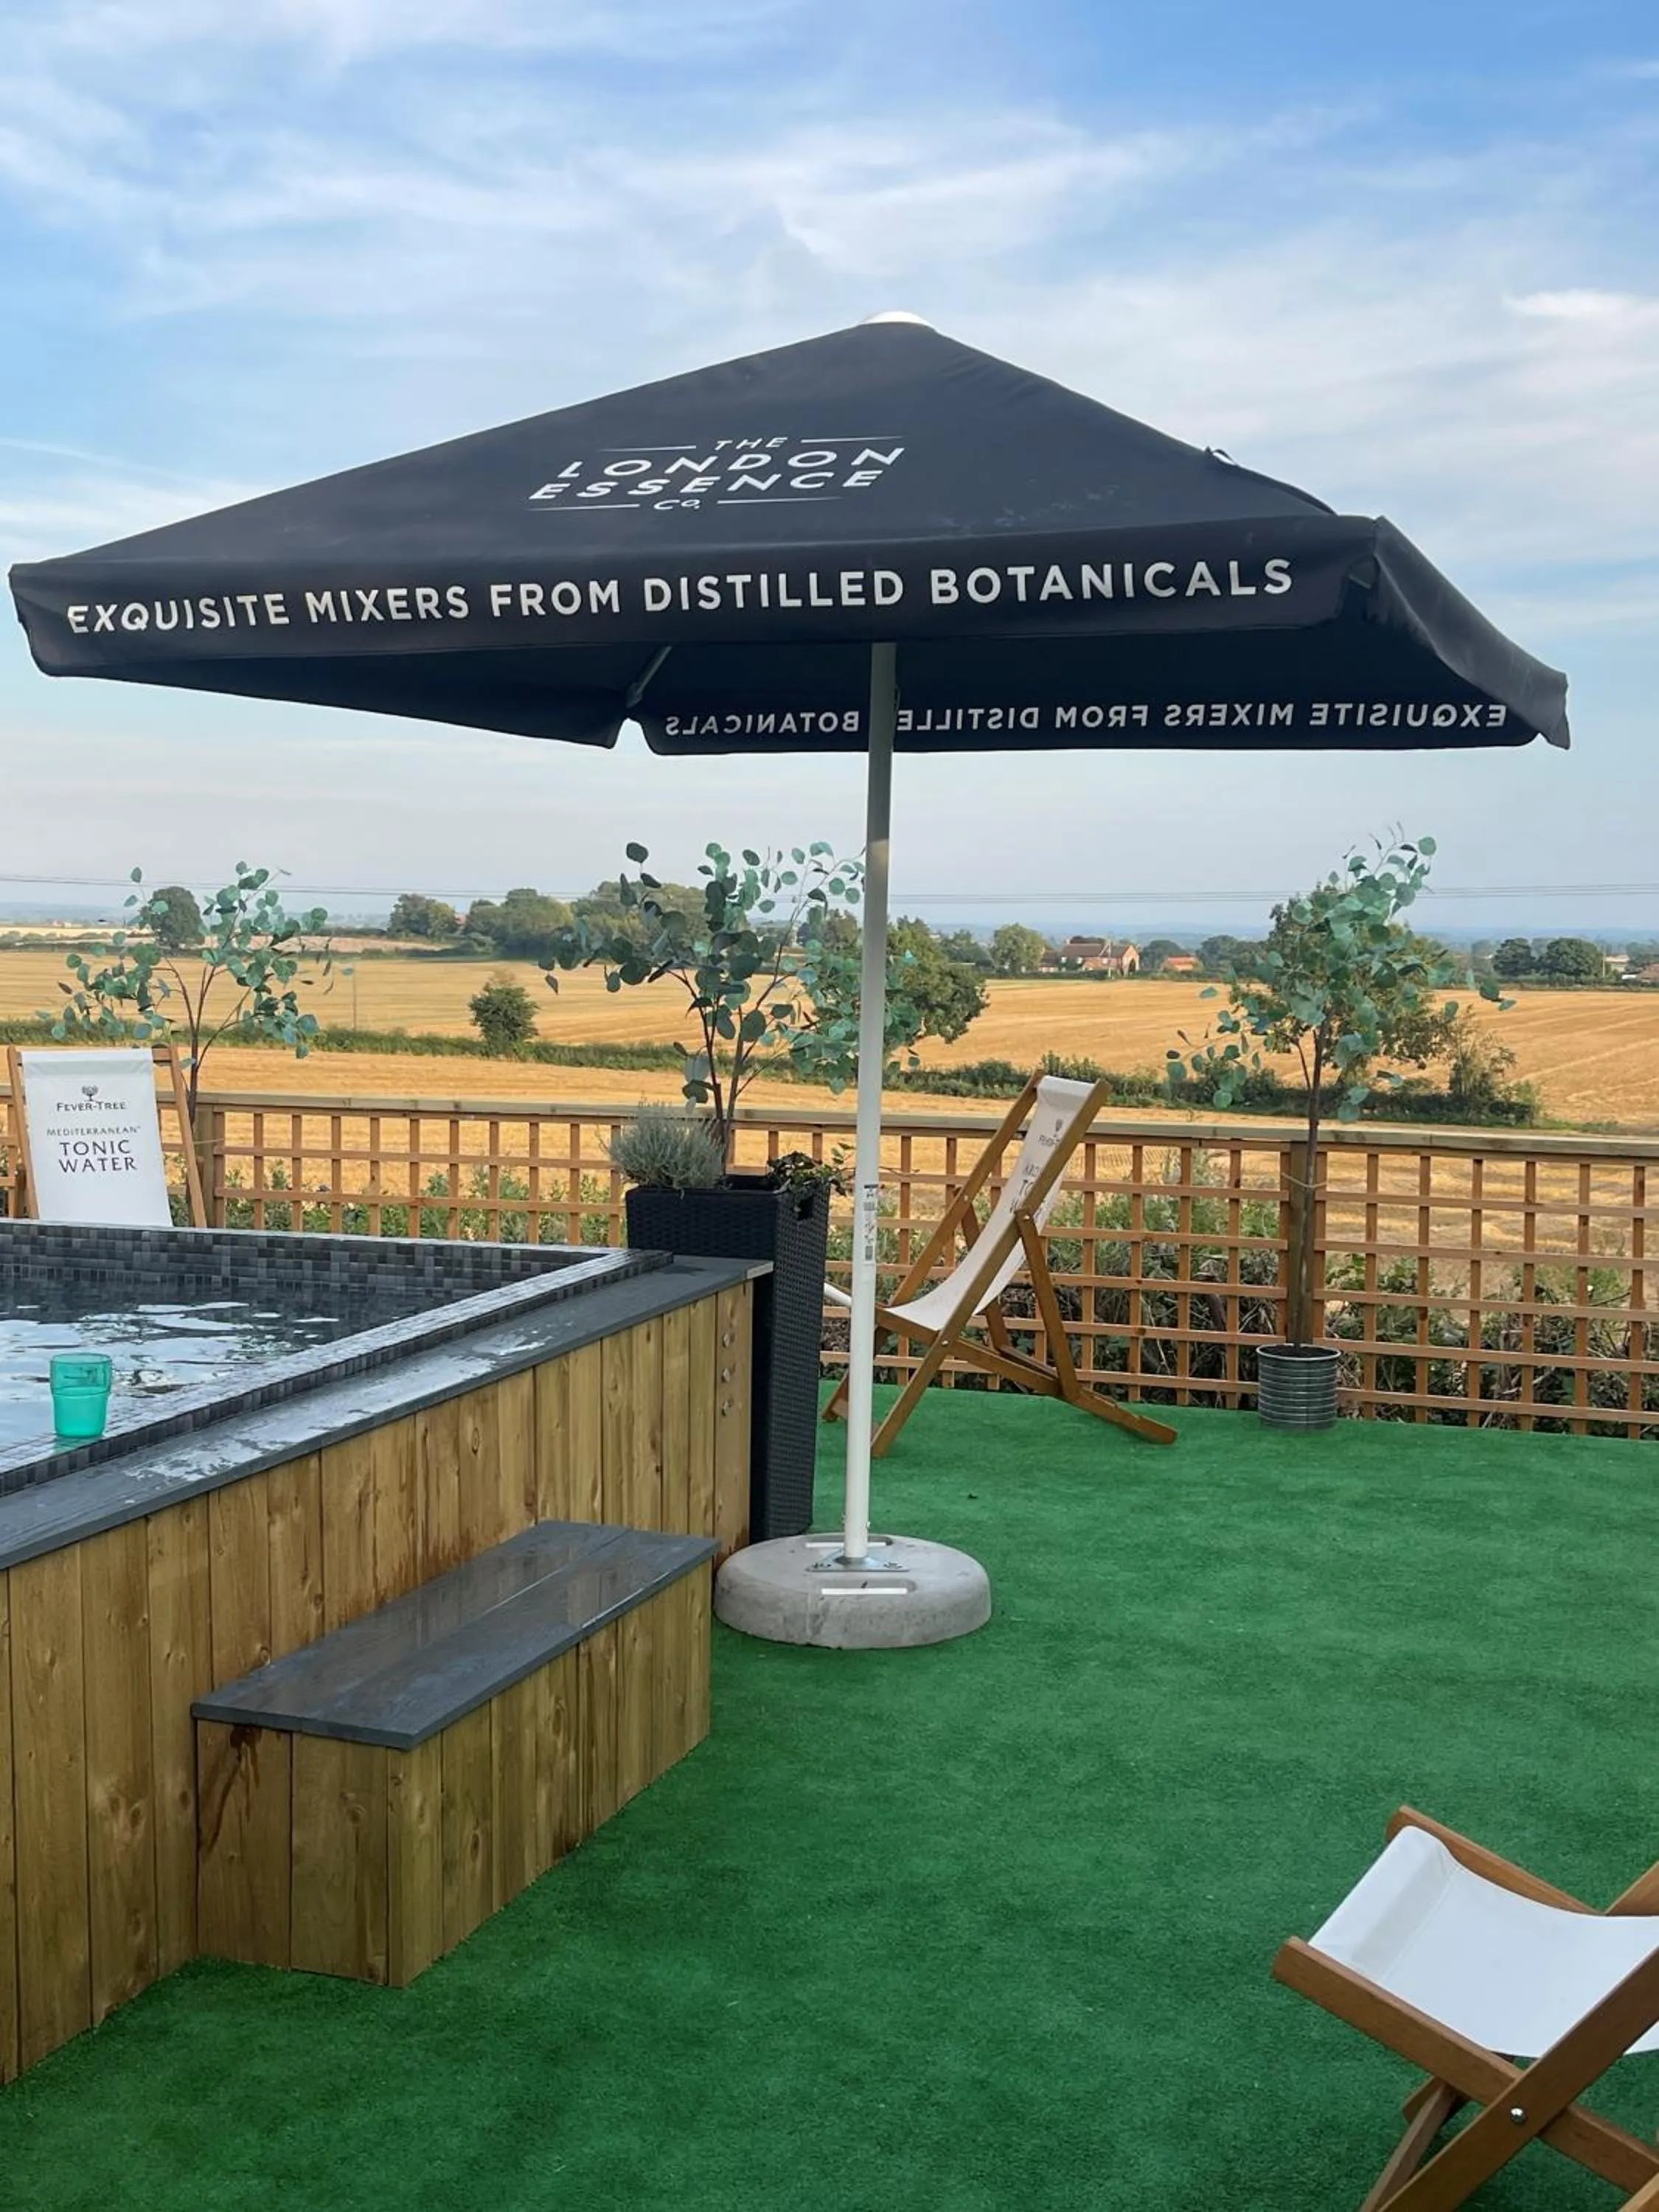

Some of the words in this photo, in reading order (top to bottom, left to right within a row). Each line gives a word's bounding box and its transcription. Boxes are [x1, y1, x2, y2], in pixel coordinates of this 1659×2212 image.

[714, 437, 788, 451] THE
[557, 448, 905, 479] LONDON
[529, 470, 883, 500] ESSENCE
[67, 594, 290, 633] EXQUISITE
[305, 585, 468, 623] MIXERS
[490, 580, 620, 617] FROM
[644, 571, 903, 611] DISTILLED
[931, 559, 1292, 604] BOTANICALS
[59, 1139, 131, 1156] TONIC
[58, 1157, 138, 1173] WATER
